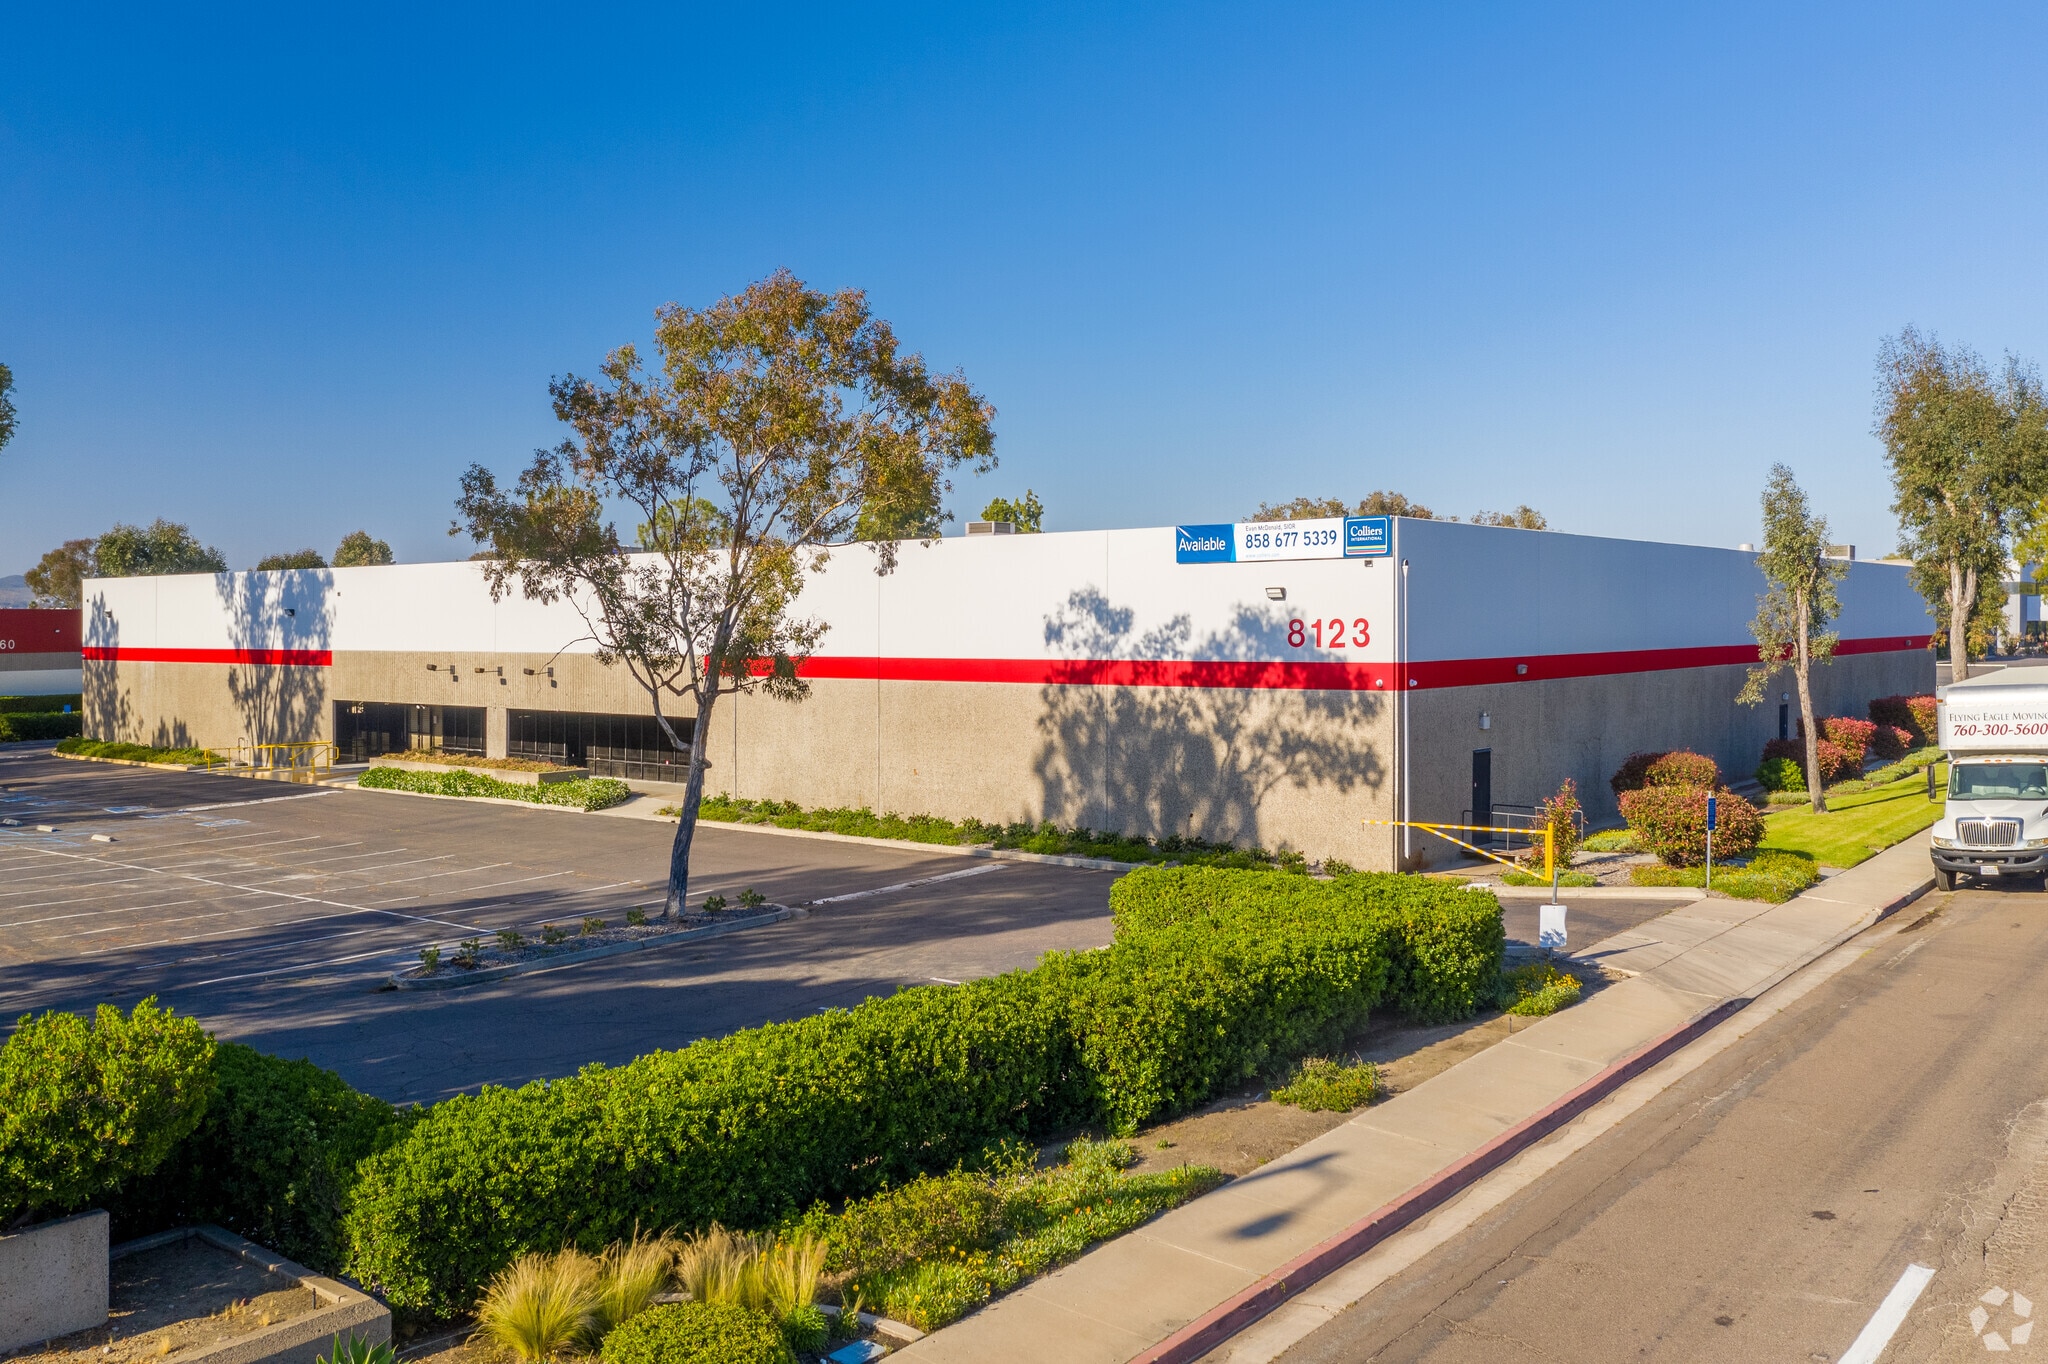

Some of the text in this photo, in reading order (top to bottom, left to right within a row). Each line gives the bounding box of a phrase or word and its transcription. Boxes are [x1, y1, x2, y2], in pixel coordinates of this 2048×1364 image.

[1350, 525, 1383, 537] Colliers
[1178, 536, 1226, 552] Available
[1245, 529, 1337, 549] 858 677 5339
[1287, 618, 1370, 648] 8123
[1949, 713, 1980, 722] FLYING
[1983, 712, 2009, 721] EAGLE
[1953, 722, 2048, 736] 760-300-5600
